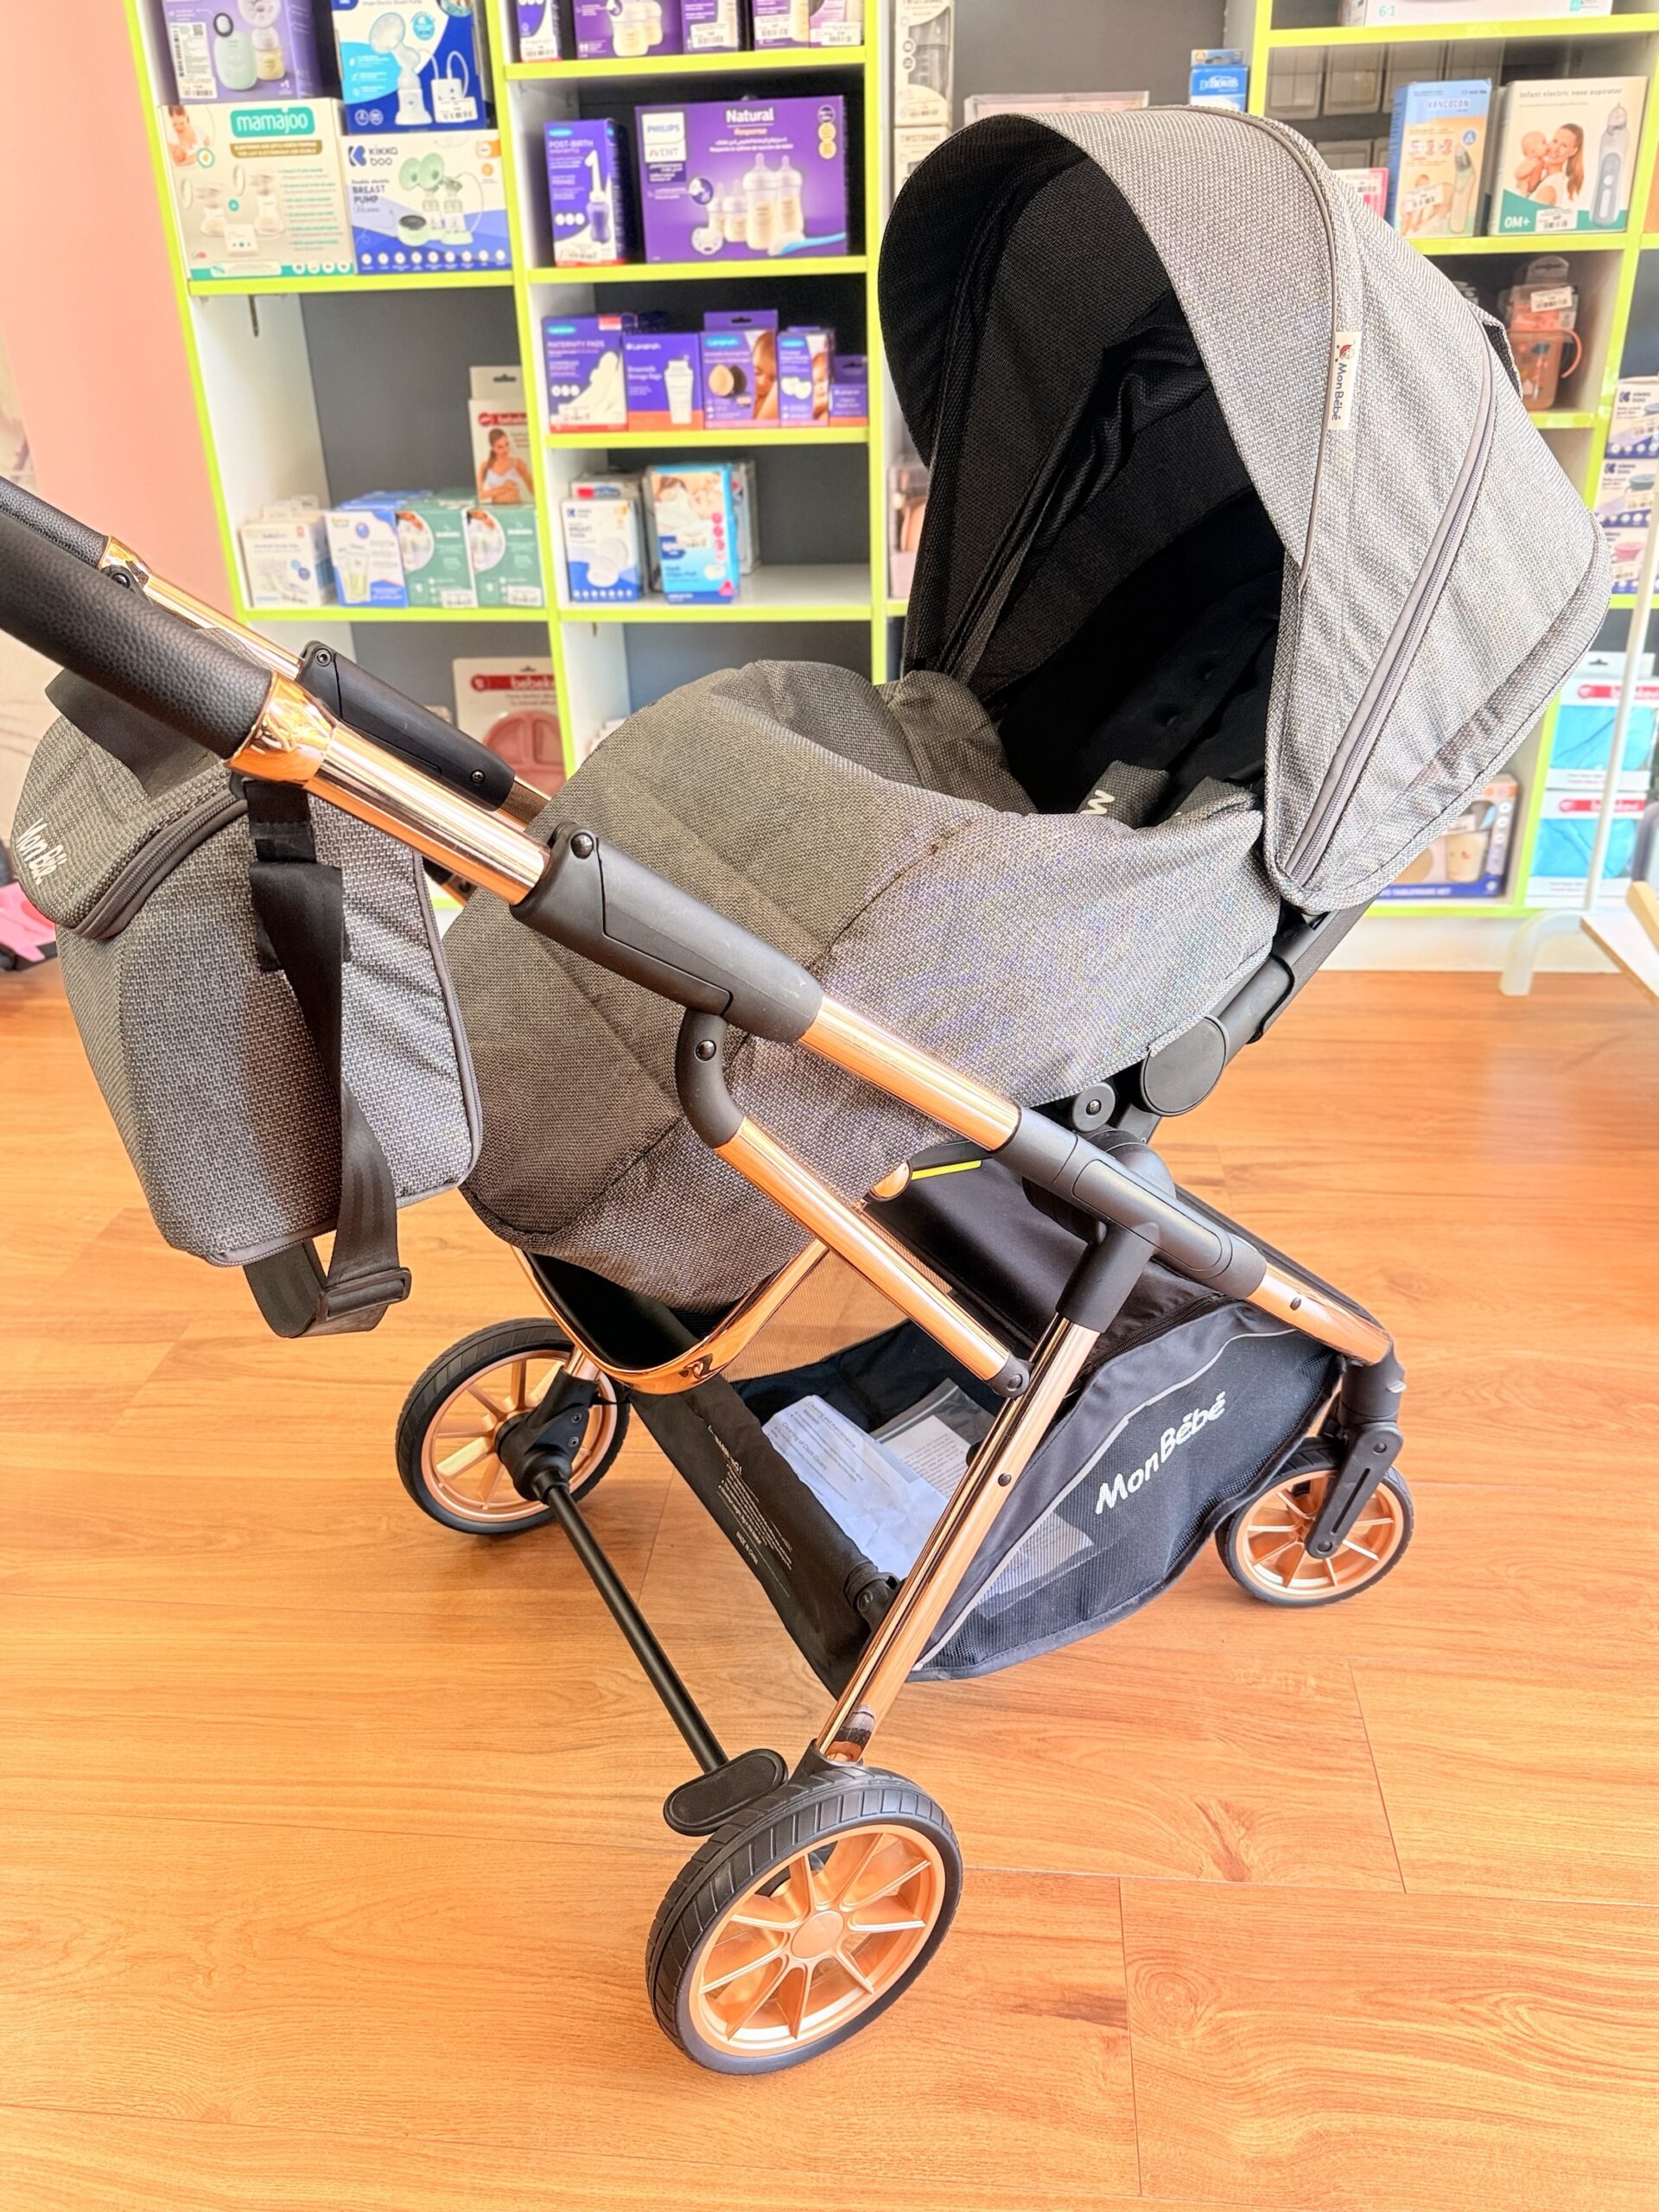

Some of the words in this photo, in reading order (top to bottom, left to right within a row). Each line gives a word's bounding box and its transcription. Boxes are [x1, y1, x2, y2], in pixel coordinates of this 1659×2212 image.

[1589, 87, 1623, 97] aspirator
[726, 107, 774, 123] Natural
[236, 110, 308, 133] mamajoo
[646, 124, 680, 133] PHILIPS
[548, 139, 594, 149] POST-BIRTH
[648, 147, 679, 157] AVENT
[352, 185, 385, 194] BREAST
[353, 195, 378, 204] PUMP
[1095, 1390, 1226, 1515] MonBébé
